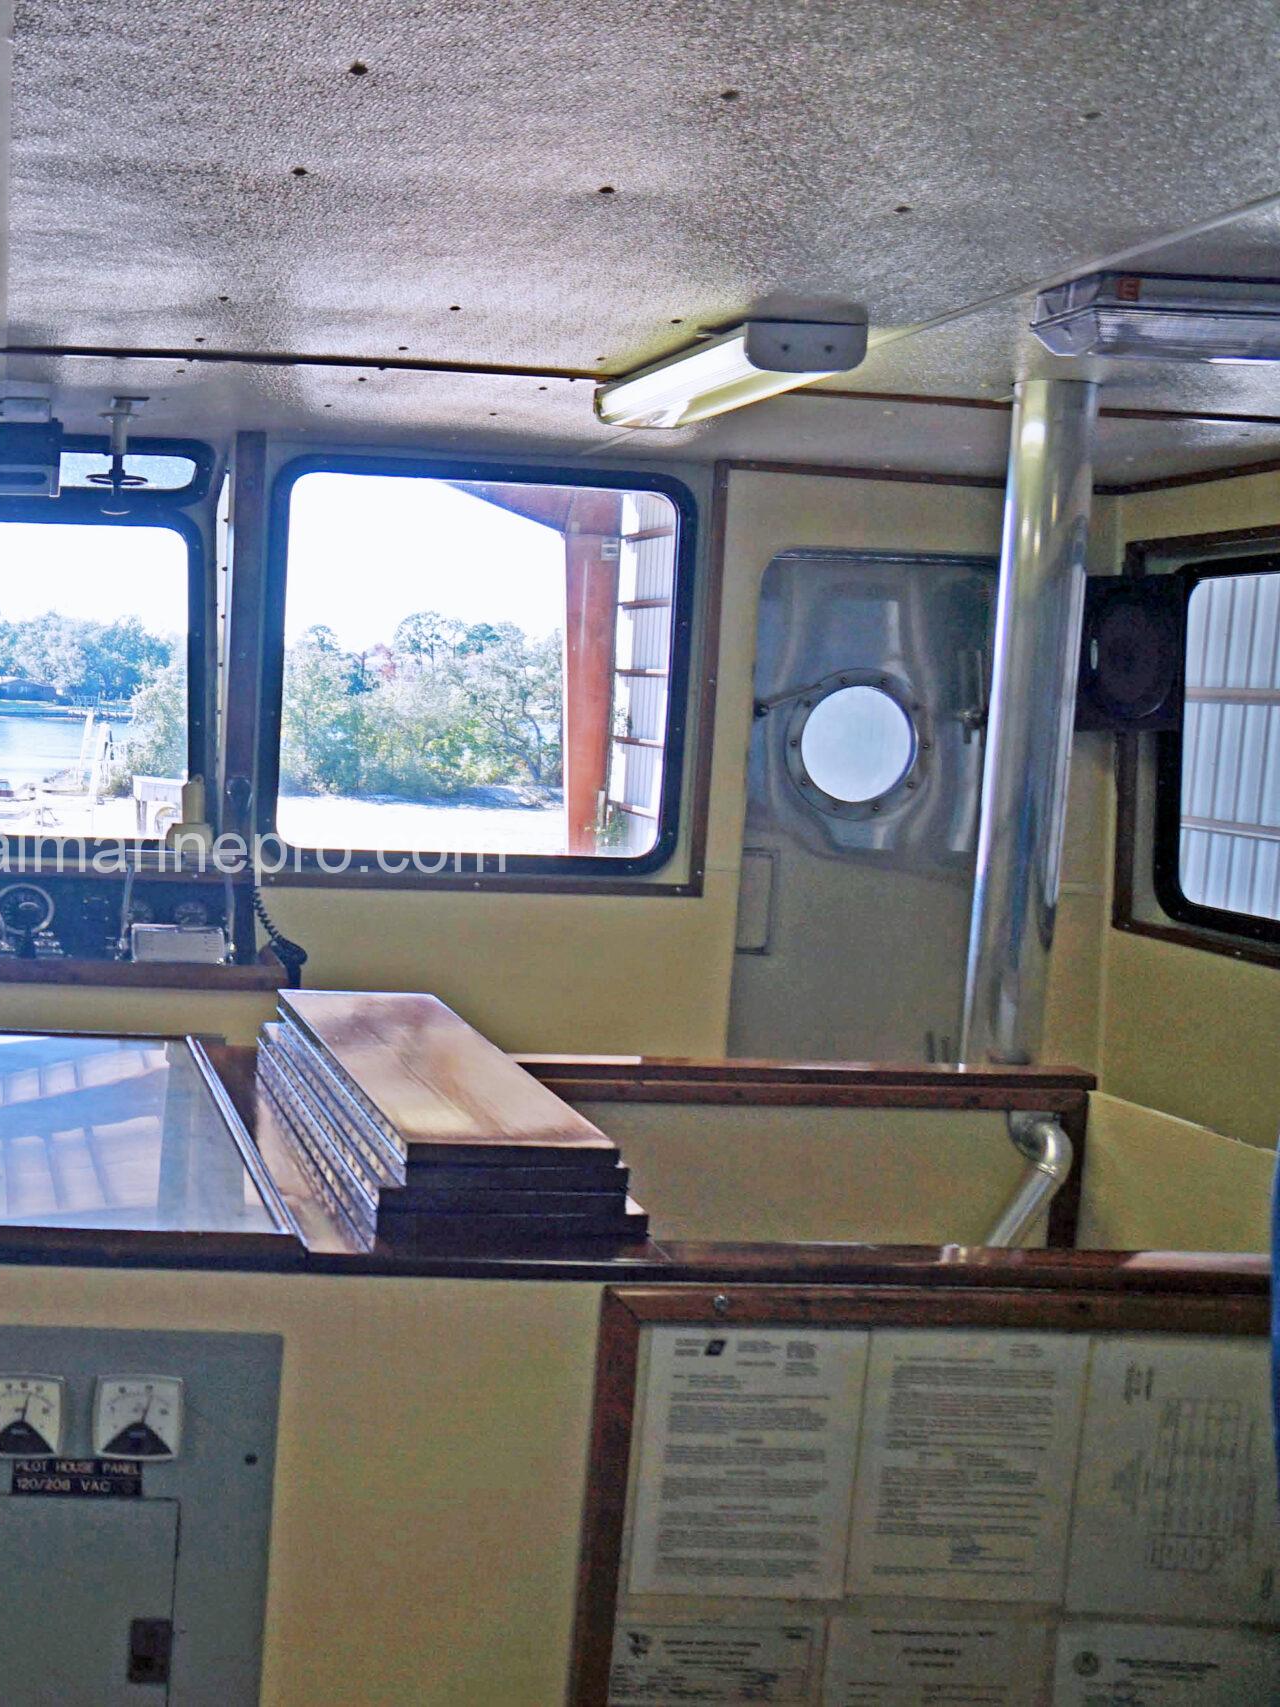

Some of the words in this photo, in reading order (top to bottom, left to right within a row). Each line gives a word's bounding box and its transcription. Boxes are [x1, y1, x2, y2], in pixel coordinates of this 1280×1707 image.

[15, 1460, 48, 1472] PILOT
[56, 1461, 95, 1474] HOUSE
[102, 1462, 139, 1475] PANEL
[80, 1479, 111, 1493] VAC
